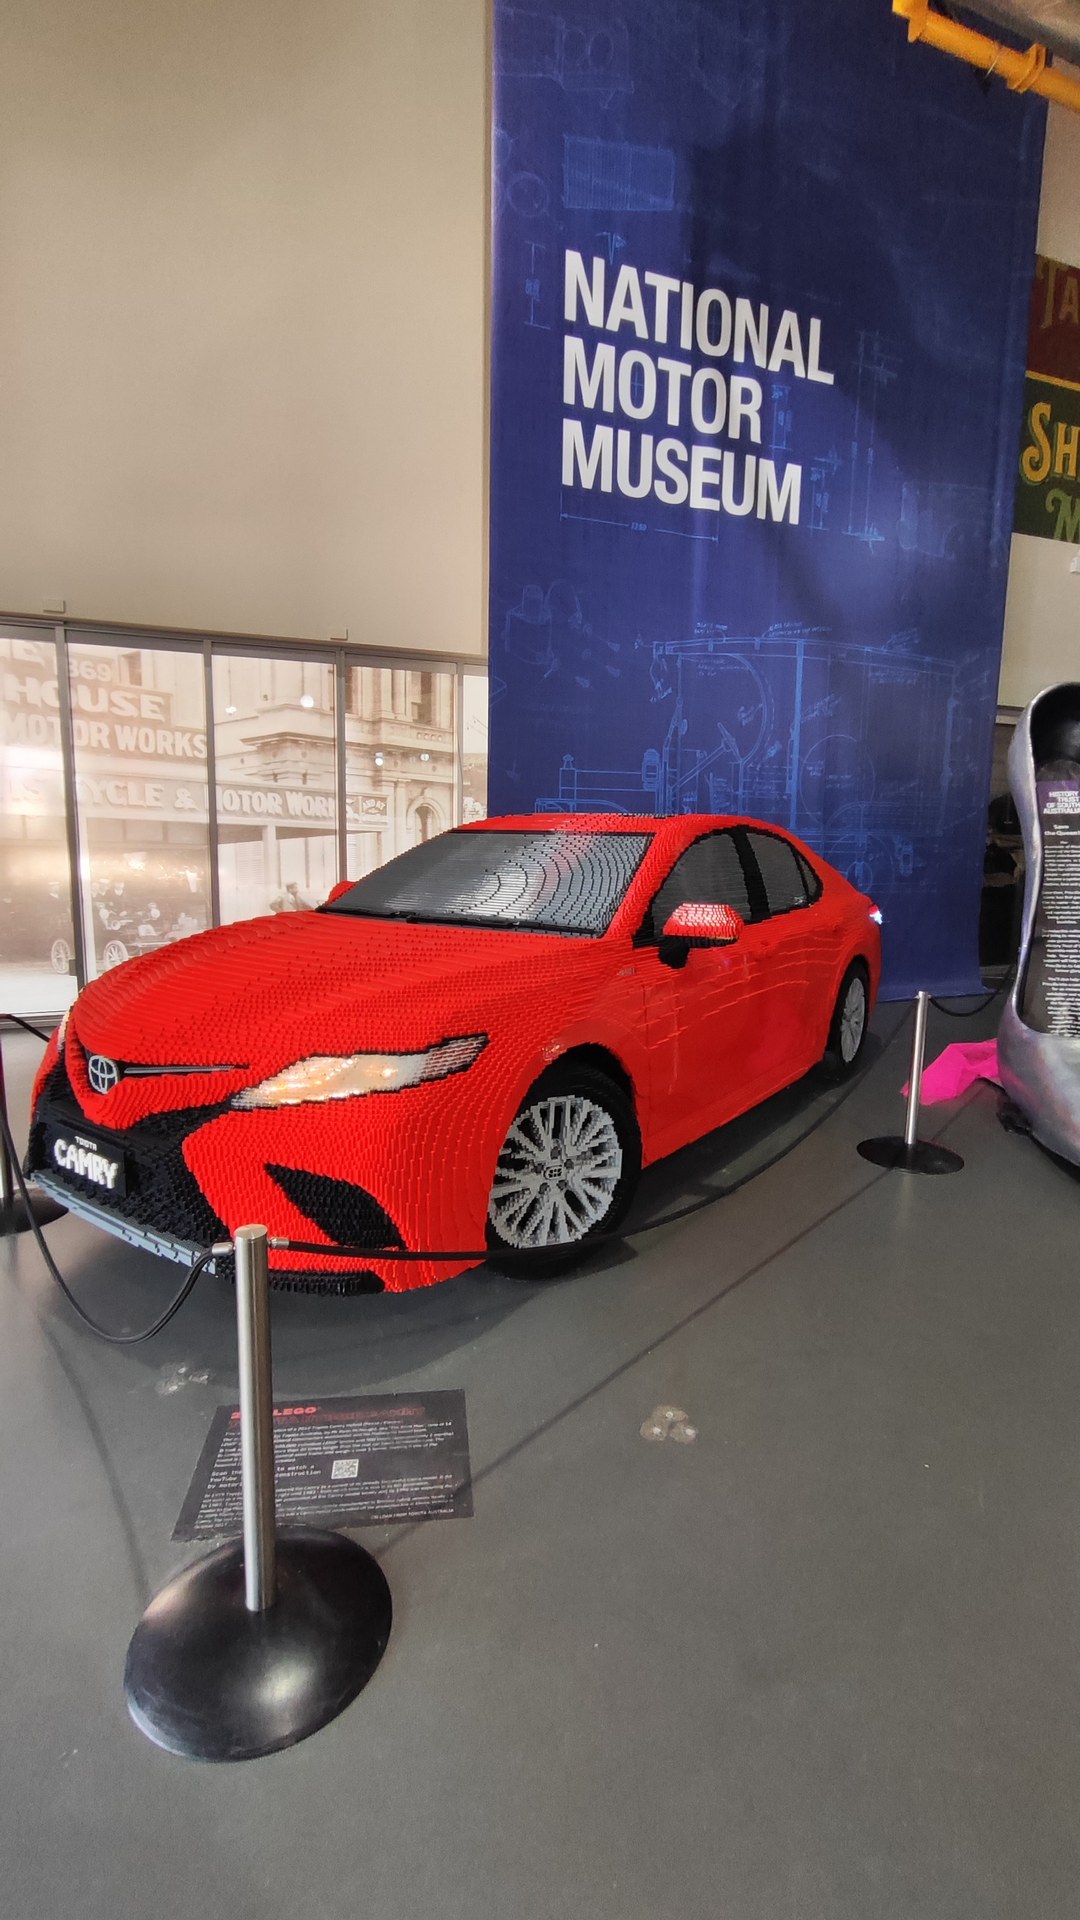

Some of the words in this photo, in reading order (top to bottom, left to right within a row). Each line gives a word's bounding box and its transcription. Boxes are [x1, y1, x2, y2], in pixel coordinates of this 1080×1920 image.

[564, 249, 834, 385] NATIONAL
[563, 335, 763, 444] MOTOR
[561, 418, 803, 525] MUSEUM
[3, 673, 166, 722] HOUSE
[2, 710, 110, 749] MOTOR
[114, 724, 208, 759] WORKS
[54, 1138, 118, 1189] CAMRY
[74, 1135, 97, 1151] TOYOTA
